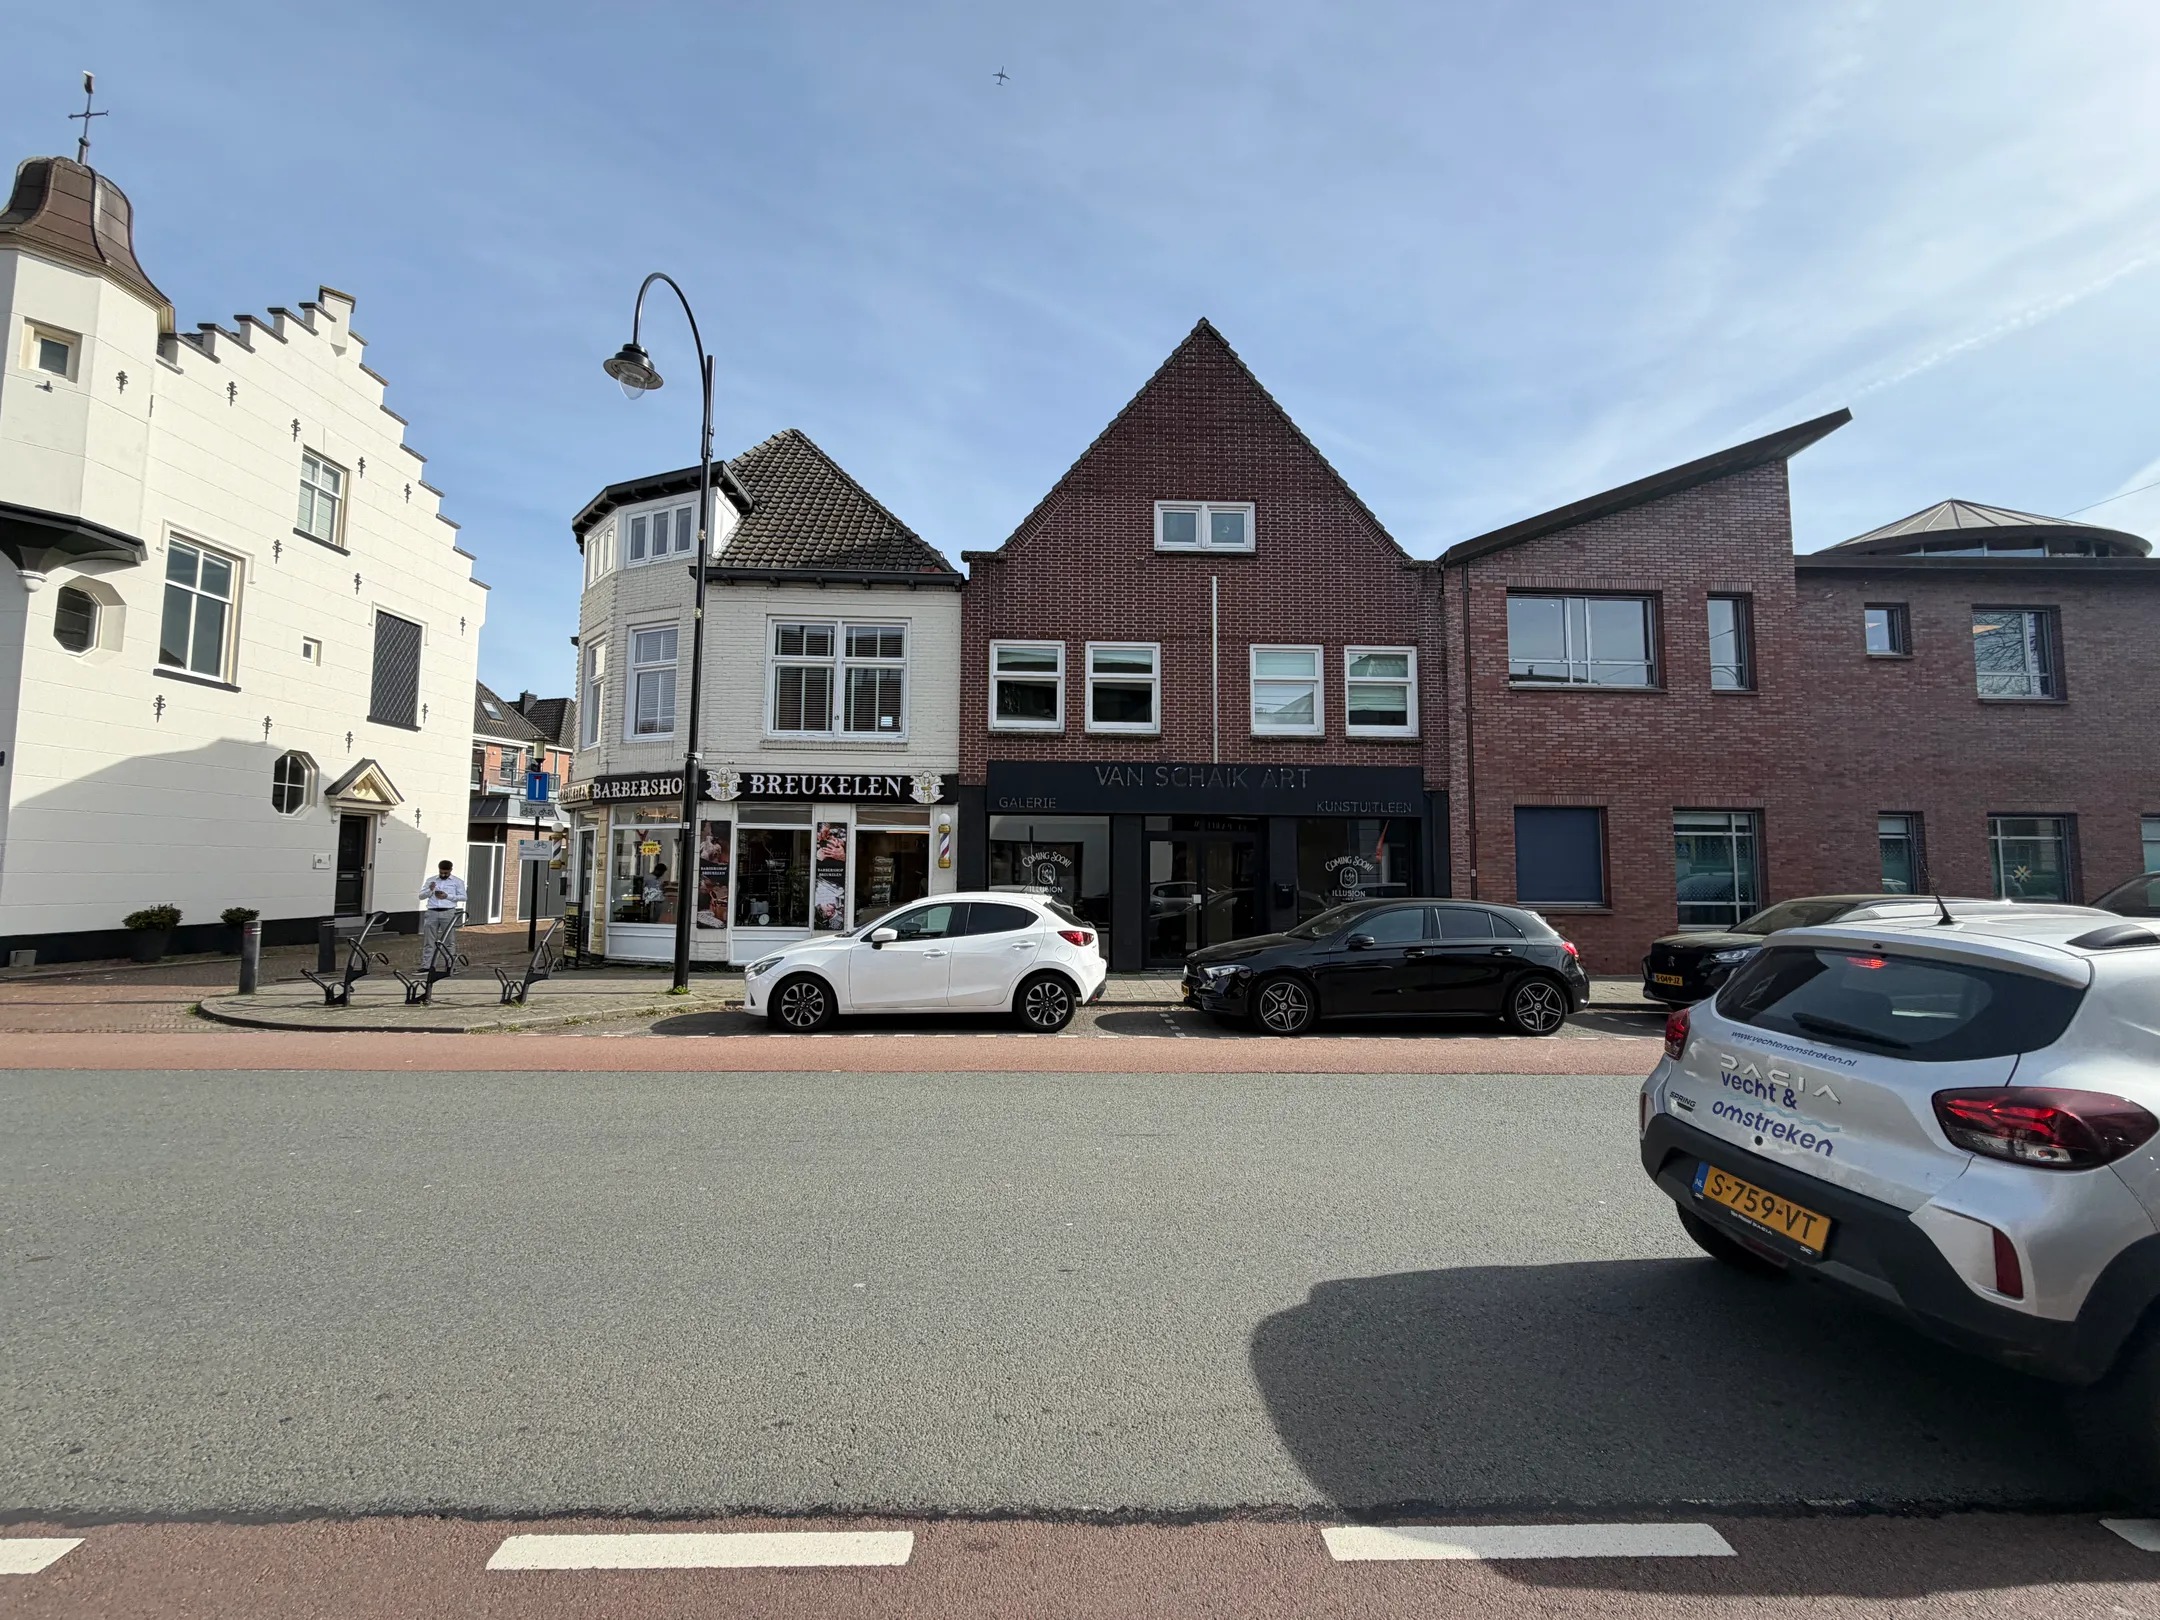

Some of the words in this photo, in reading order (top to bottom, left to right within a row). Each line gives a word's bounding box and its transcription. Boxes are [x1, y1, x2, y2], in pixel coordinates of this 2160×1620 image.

[593, 777, 684, 799] BARBERSHO
[750, 773, 903, 797] BREUKELEN
[1095, 766, 1144, 787] VAN
[1155, 766, 1249, 788] SCHAIK
[1261, 767, 1311, 789] ART
[999, 797, 1056, 809] GALERIE
[1316, 800, 1413, 813] KUNSTUITLEEN
[1021, 851, 1050, 868] COMING
[1325, 855, 1352, 872] COMING
[1332, 889, 1366, 897] ILLUSION
[1731, 1030, 1858, 1068] www.vechtenomstreken.nl
[1720, 1052, 1842, 1105] DACIA
[1669, 1090, 1697, 1109] SPRING
[1720, 1070, 1776, 1103] vecht
[1782, 1087, 1798, 1110] &
[1712, 1100, 1834, 1157] omstreken
[1710, 1173, 1818, 1240] S-759-VT
